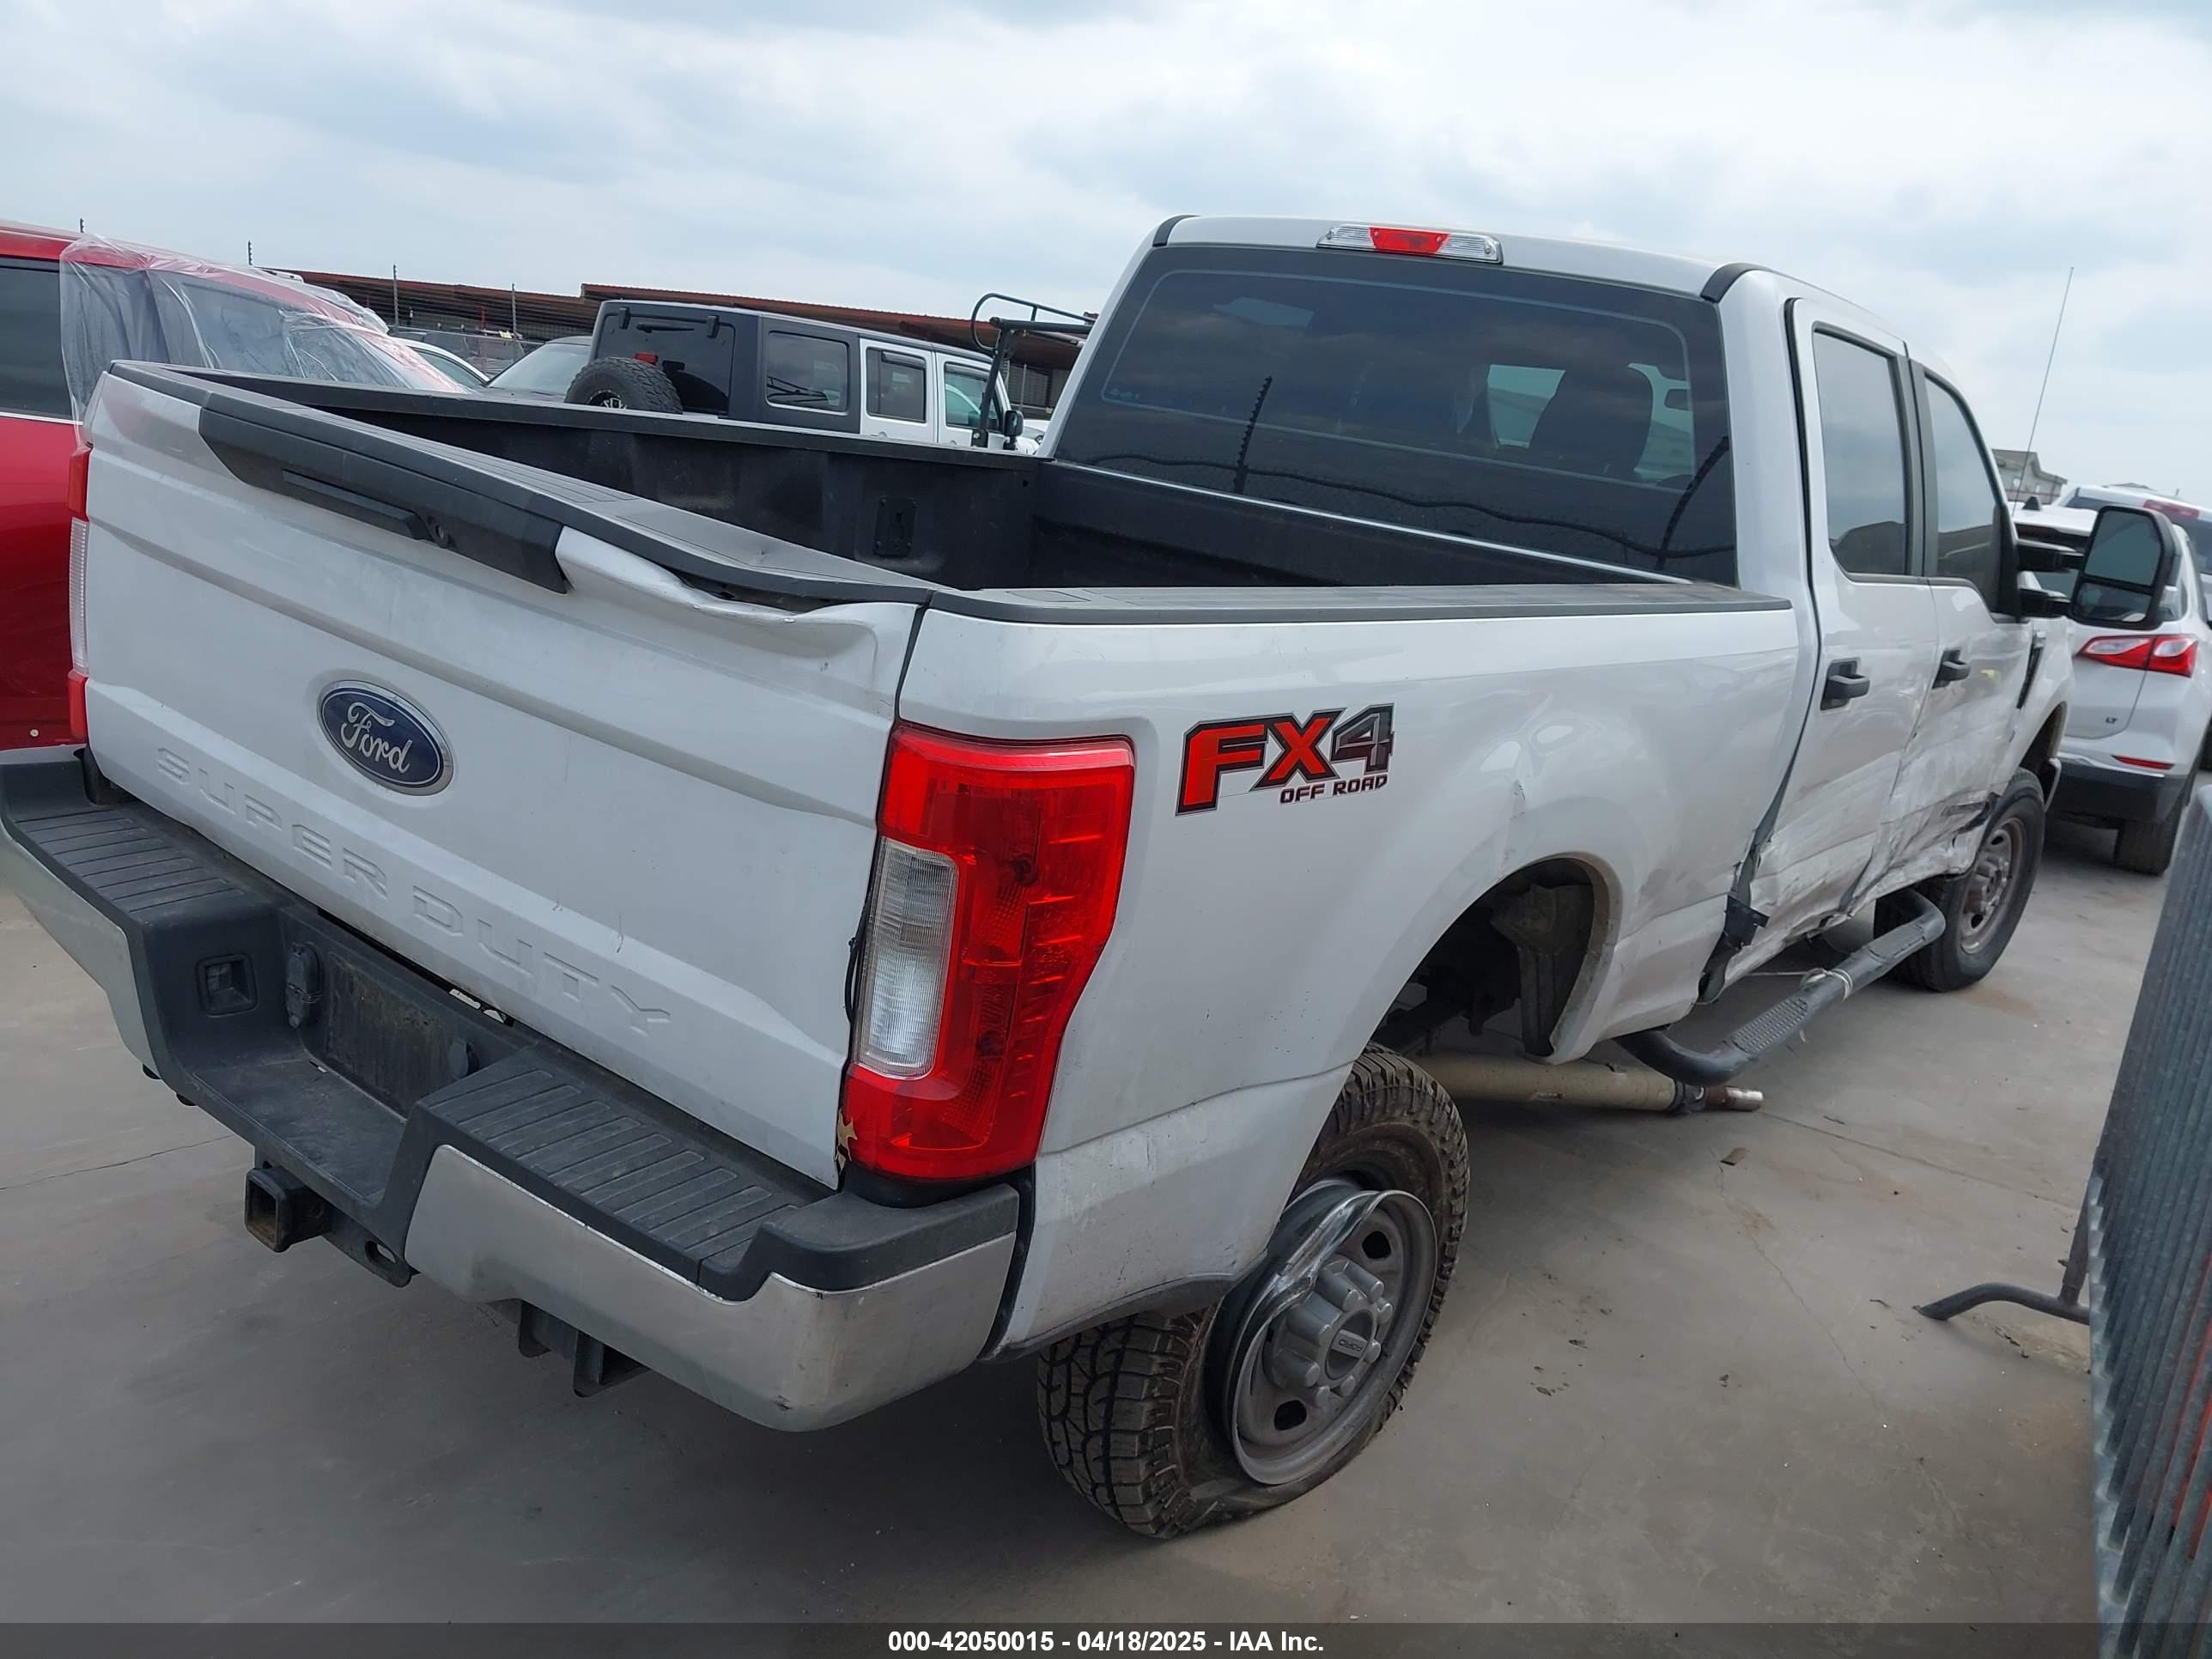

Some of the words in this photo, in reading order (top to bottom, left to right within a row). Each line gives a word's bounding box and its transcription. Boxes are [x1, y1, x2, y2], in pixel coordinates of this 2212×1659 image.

[340, 701, 413, 774] Ford
[1175, 702, 1395, 817] FX4
[1279, 783, 1325, 805] OFF
[1332, 774, 1389, 797] ROAD
[157, 747, 387, 900] SUPER
[412, 884, 672, 1036] DUTY
